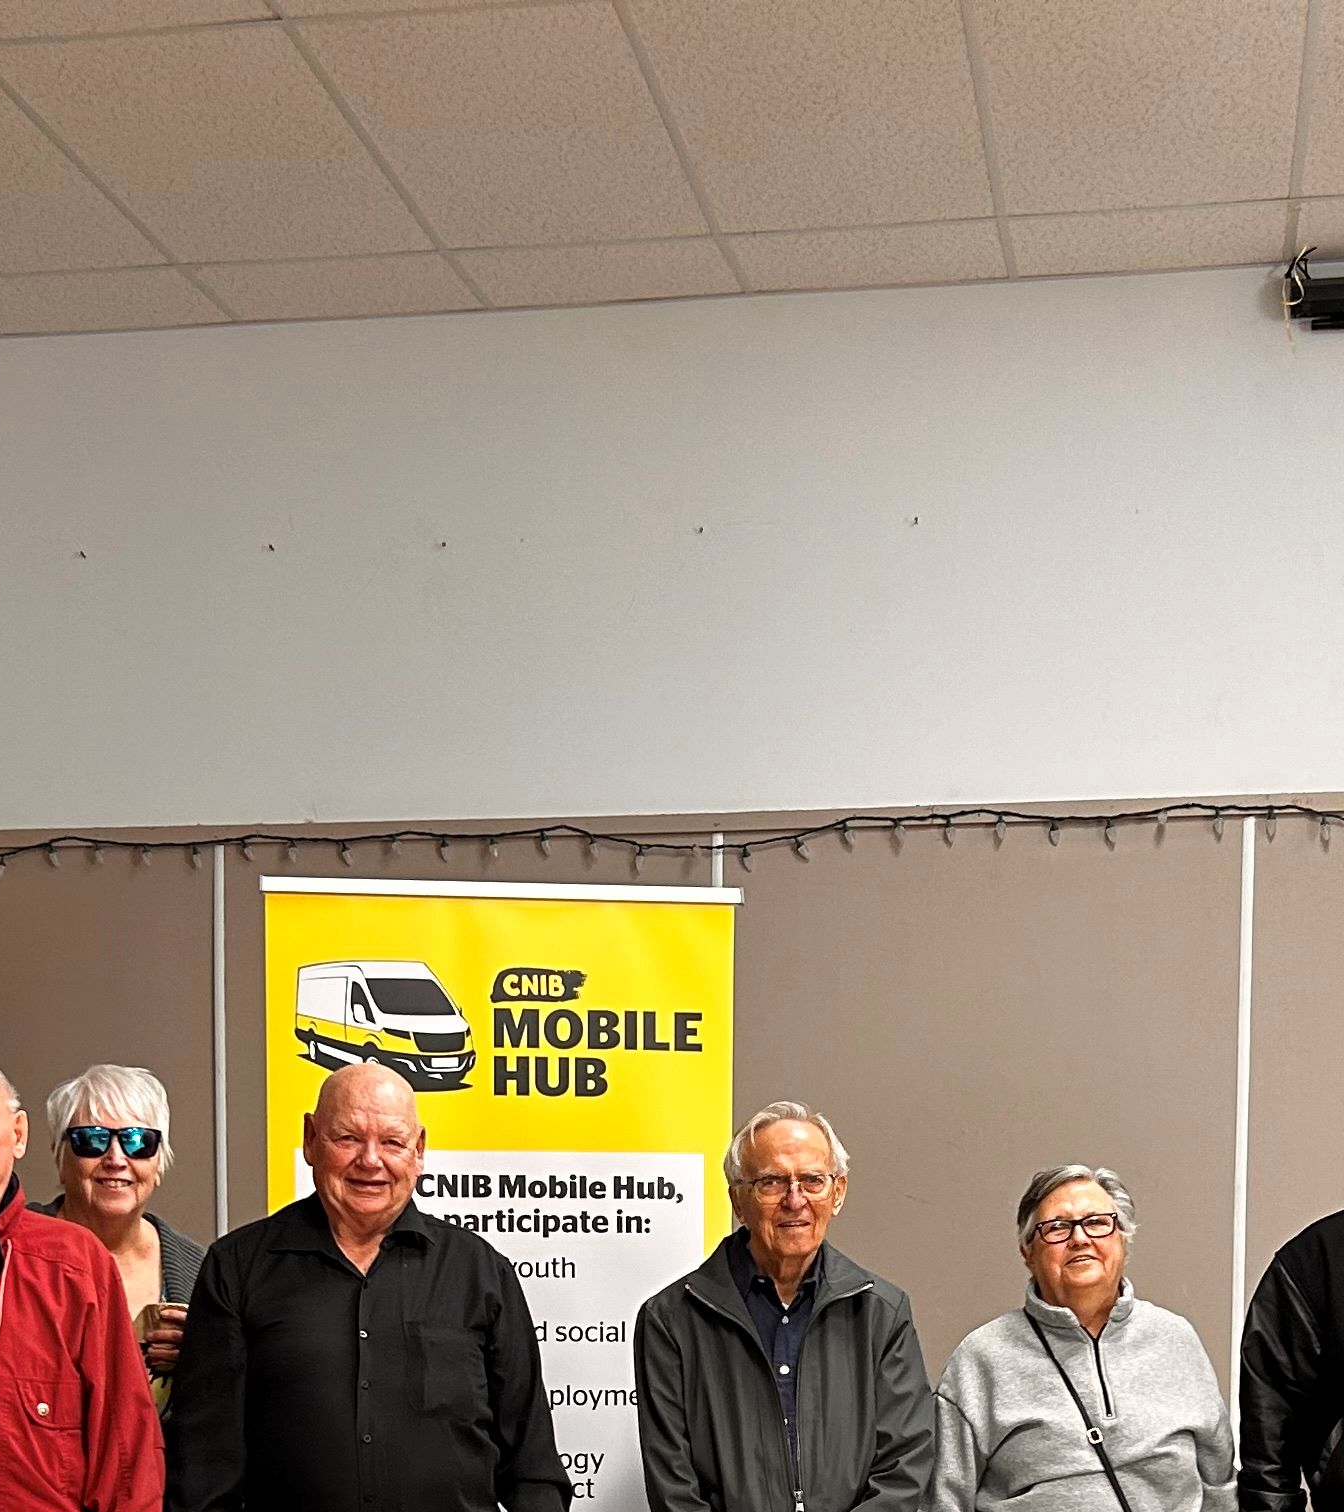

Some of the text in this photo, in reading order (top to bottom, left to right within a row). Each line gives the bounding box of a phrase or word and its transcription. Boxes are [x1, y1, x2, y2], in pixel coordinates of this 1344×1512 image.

[502, 974, 565, 997] CNIB
[494, 1008, 703, 1052] MOBILE
[494, 1055, 608, 1097] HUB
[415, 1174, 684, 1204] CNIB Mobile Hub,
[616, 1209, 651, 1234] in:
[512, 1257, 576, 1279] outh
[555, 1321, 626, 1342] social
